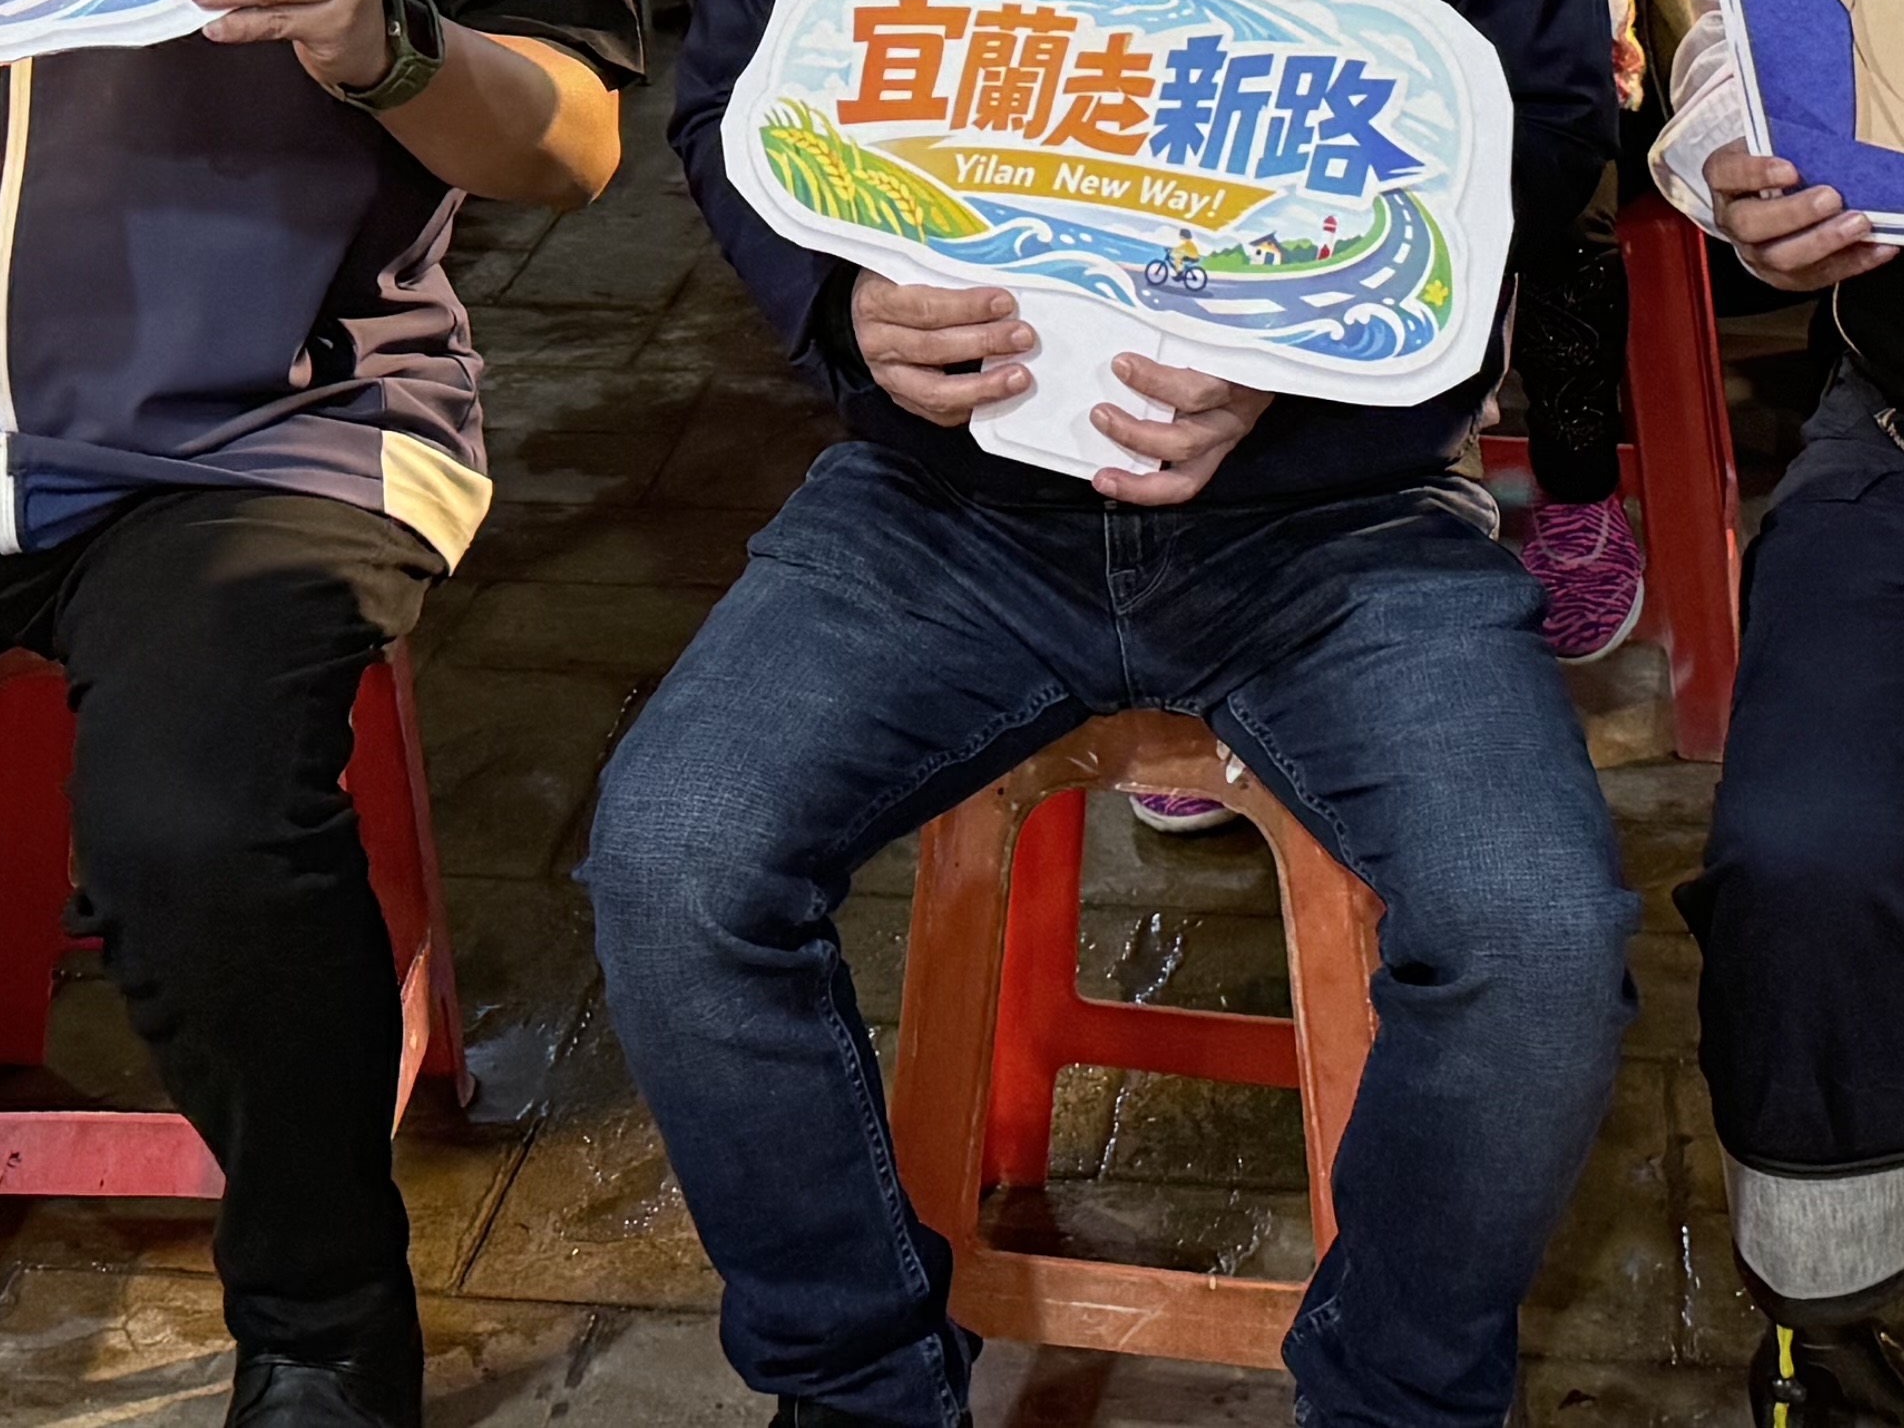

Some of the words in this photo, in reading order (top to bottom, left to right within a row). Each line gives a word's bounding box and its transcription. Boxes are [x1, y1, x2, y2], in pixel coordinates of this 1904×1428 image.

[952, 153, 1036, 191] Yilan
[1050, 165, 1130, 201] New
[1136, 176, 1226, 225] Way!
